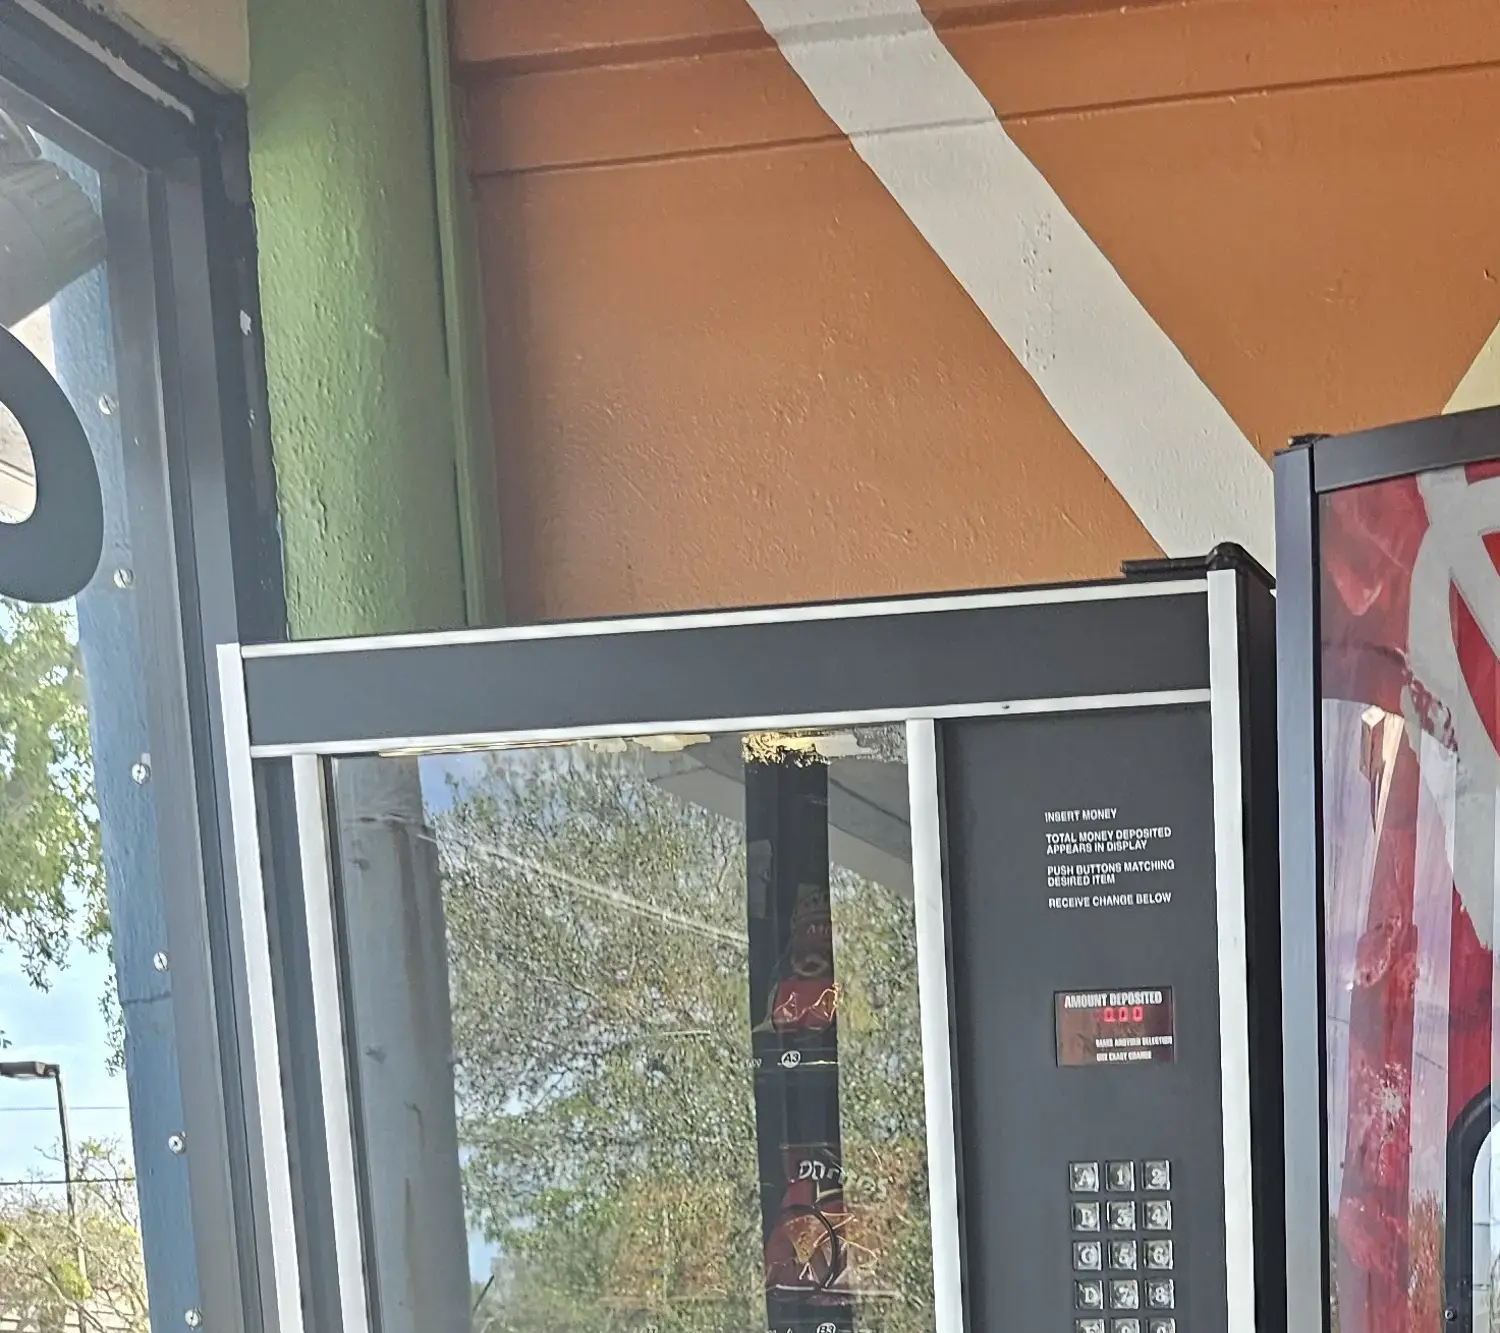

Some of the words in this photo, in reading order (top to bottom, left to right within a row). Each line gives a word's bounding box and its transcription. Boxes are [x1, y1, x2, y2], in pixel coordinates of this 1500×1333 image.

[1044, 810, 1080, 823] INSERT
[1082, 808, 1117, 821] MONEY
[1046, 832, 1077, 844] TOTAL
[1079, 830, 1114, 842] MONEY
[1116, 826, 1171, 840] DEPOSITED
[1046, 842, 1092, 855] APPEARS
[1094, 842, 1104, 852] IN
[1106, 840, 1148, 852] DISPLAY
[1047, 864, 1074, 876] PUSH
[1075, 862, 1121, 875] BUTTONS
[1123, 859, 1174, 872] MATCHING
[1047, 875, 1090, 887] DESIRED
[1092, 873, 1115, 885] ITEM
[1048, 896, 1090, 909] RECEIVE
[1092, 894, 1133, 906] CHANGE
[1136, 892, 1171, 905] BELOW
[1064, 993, 1107, 1008] AMOUNT
[1109, 990, 1162, 1006] DEPOSITED
[783, 1052, 799, 1063] A3
[1078, 1170, 1091, 1186] A
[1116, 1170, 1124, 1185] 1
[1152, 1169, 1162, 1184] 2
[1117, 1210, 1129, 1225] 3
[1152, 1209, 1164, 1223] 4
[1119, 1249, 1130, 1264] 5
[1153, 1248, 1164, 1263] 6
[1084, 1288, 1098, 1303] D
[1120, 1287, 1130, 1303] 7
[1155, 1287, 1166, 1302] 8
